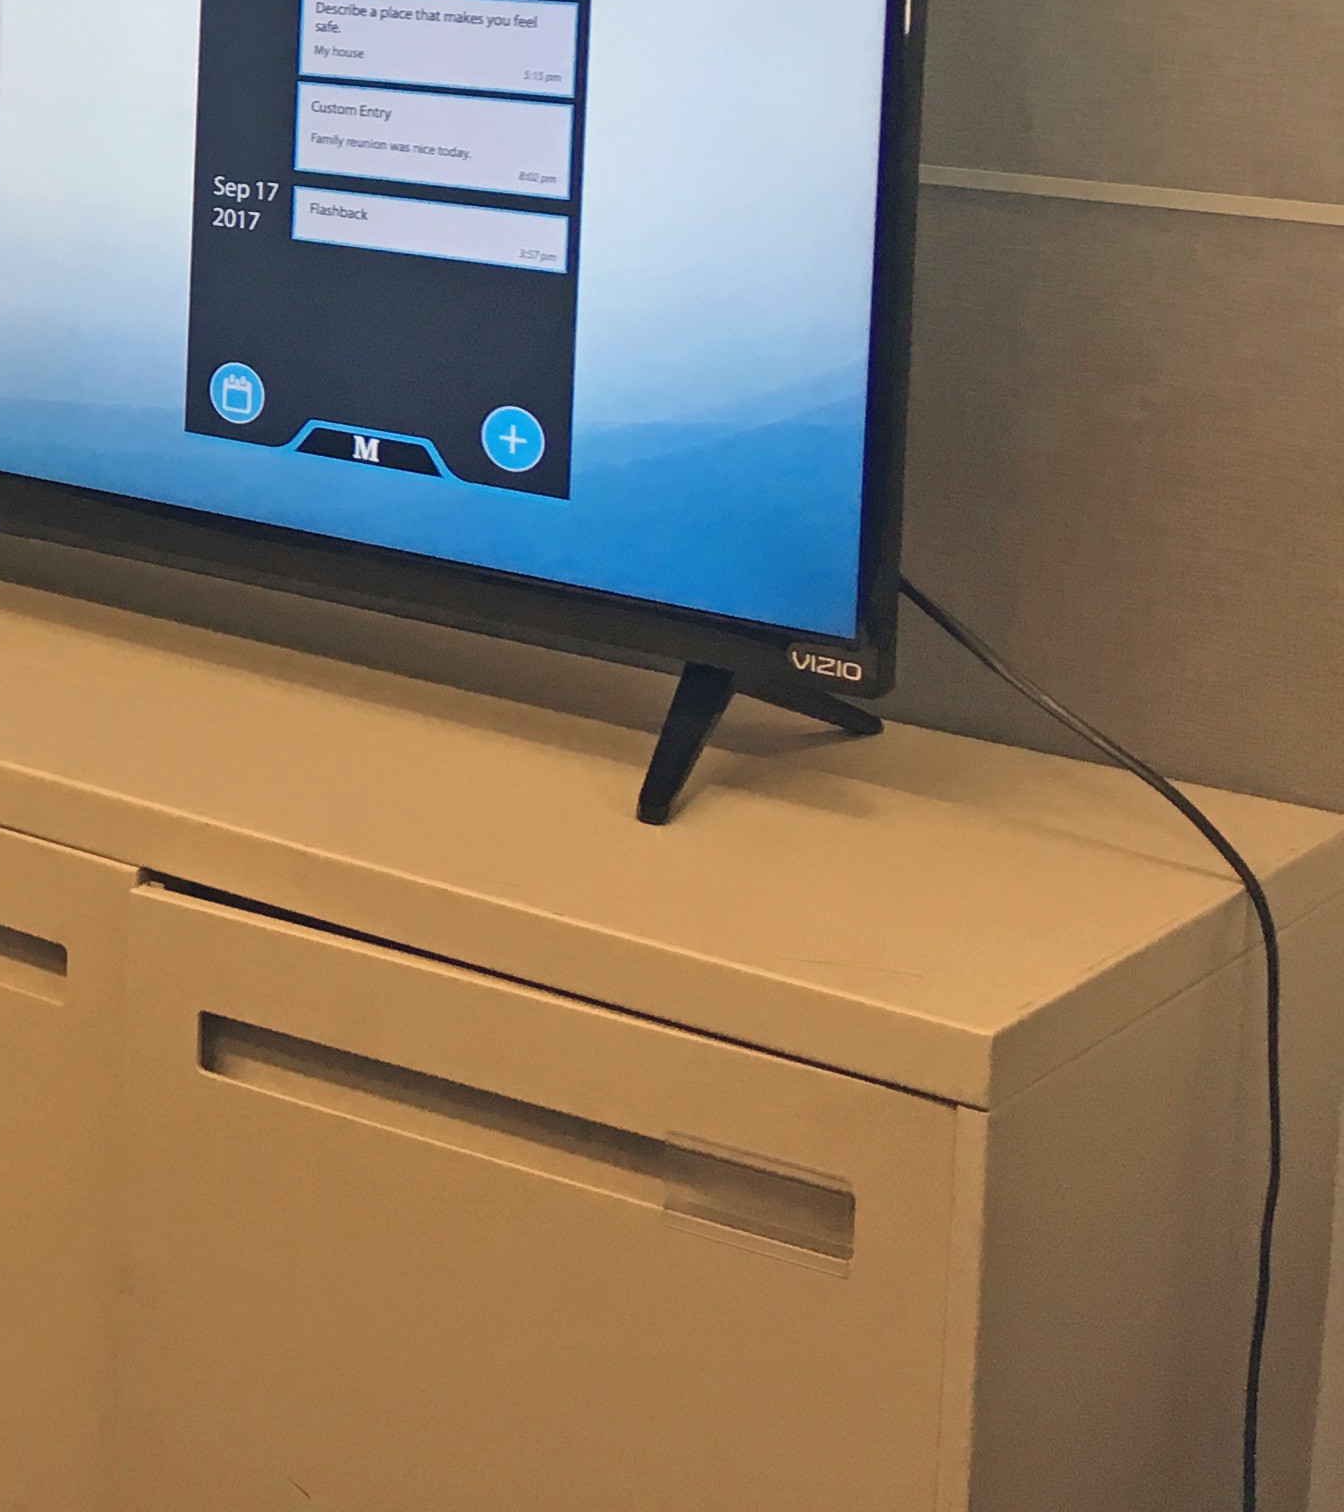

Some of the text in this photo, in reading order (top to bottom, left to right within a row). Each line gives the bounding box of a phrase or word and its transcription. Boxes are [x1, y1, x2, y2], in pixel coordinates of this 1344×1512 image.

[315, 1, 538, 29] Describe a place that makes you feel
[315, 20, 341, 35] safe.
[314, 45, 365, 59] My house
[311, 100, 392, 122] Custom Entry
[310, 132, 472, 160] Family reunion was nice today.
[213, 176, 279, 202] Sep 17
[540, 173, 557, 186] pm
[212, 207, 261, 231] 2017
[309, 202, 368, 221] Flashback
[352, 434, 381, 463] M
[792, 651, 862, 681] VIZIO
